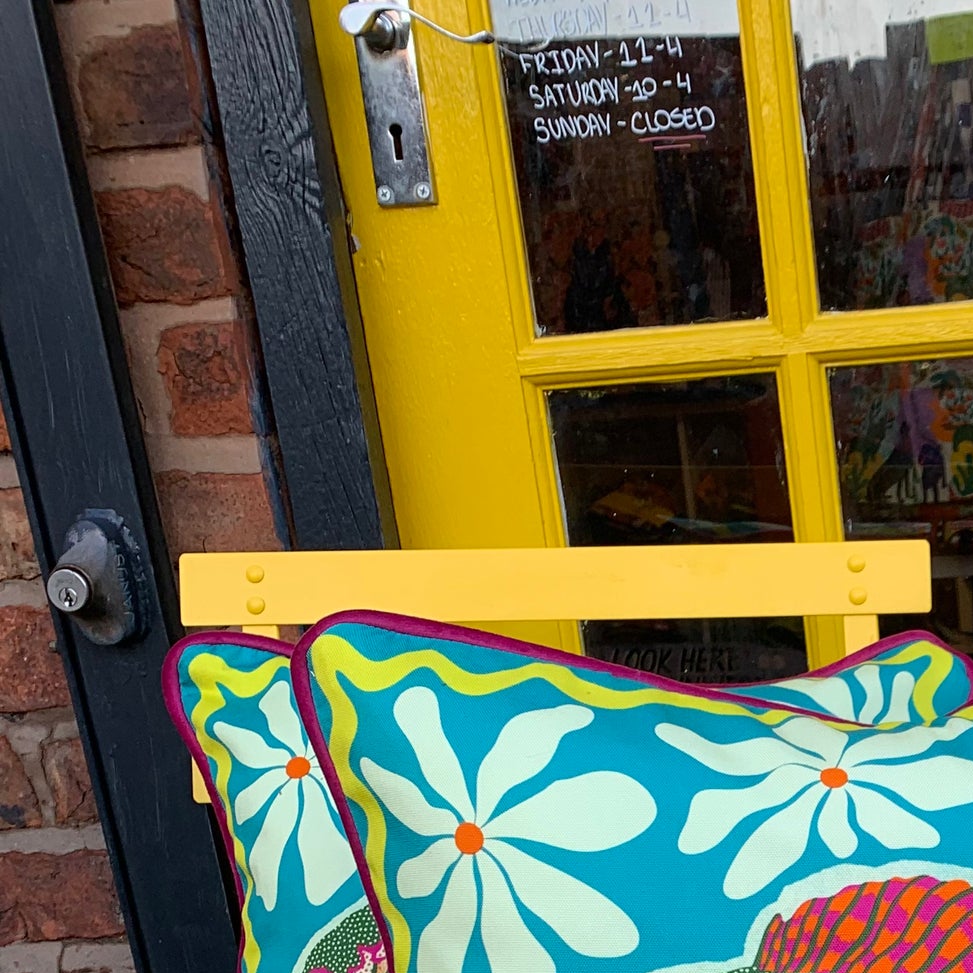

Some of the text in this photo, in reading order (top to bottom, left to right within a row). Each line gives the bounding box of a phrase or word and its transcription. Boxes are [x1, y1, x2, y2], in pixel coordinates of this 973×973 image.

[519, 41, 600, 75] FRIDAY
[529, 76, 619, 110] SATURDAY
[534, 113, 611, 144] SUNDAY
[631, 105, 716, 135] CLOSED
